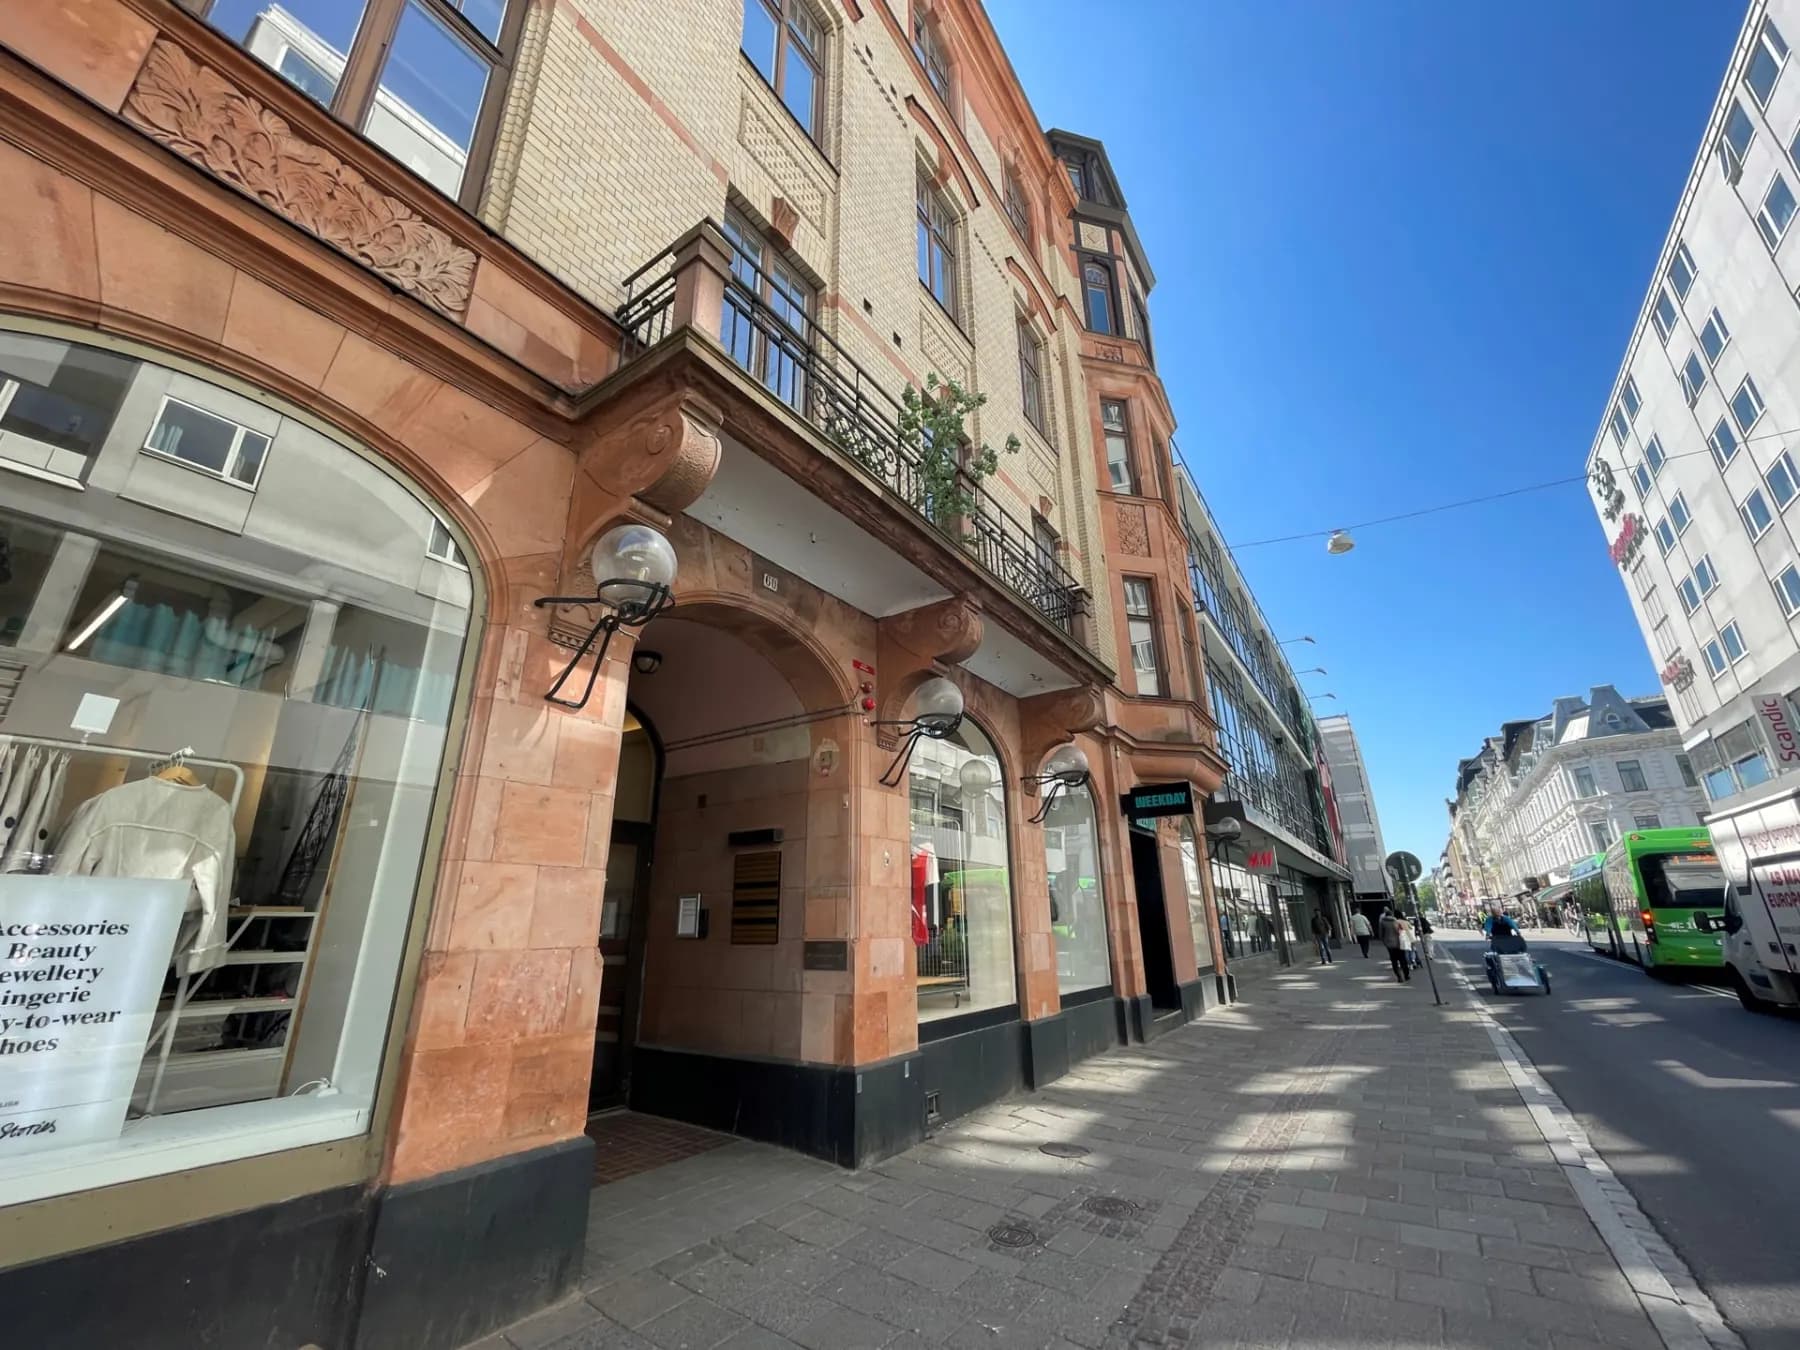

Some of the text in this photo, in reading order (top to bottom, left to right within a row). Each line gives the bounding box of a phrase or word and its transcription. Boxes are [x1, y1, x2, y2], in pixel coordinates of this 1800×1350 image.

[1760, 698, 1800, 762] Scandic
[1135, 791, 1186, 808] WEEKDAY
[1769, 870, 1783, 886] AB
[0, 919, 129, 937] ccessories
[6, 942, 97, 961] Beauty
[0, 1120, 57, 1139] Stories
